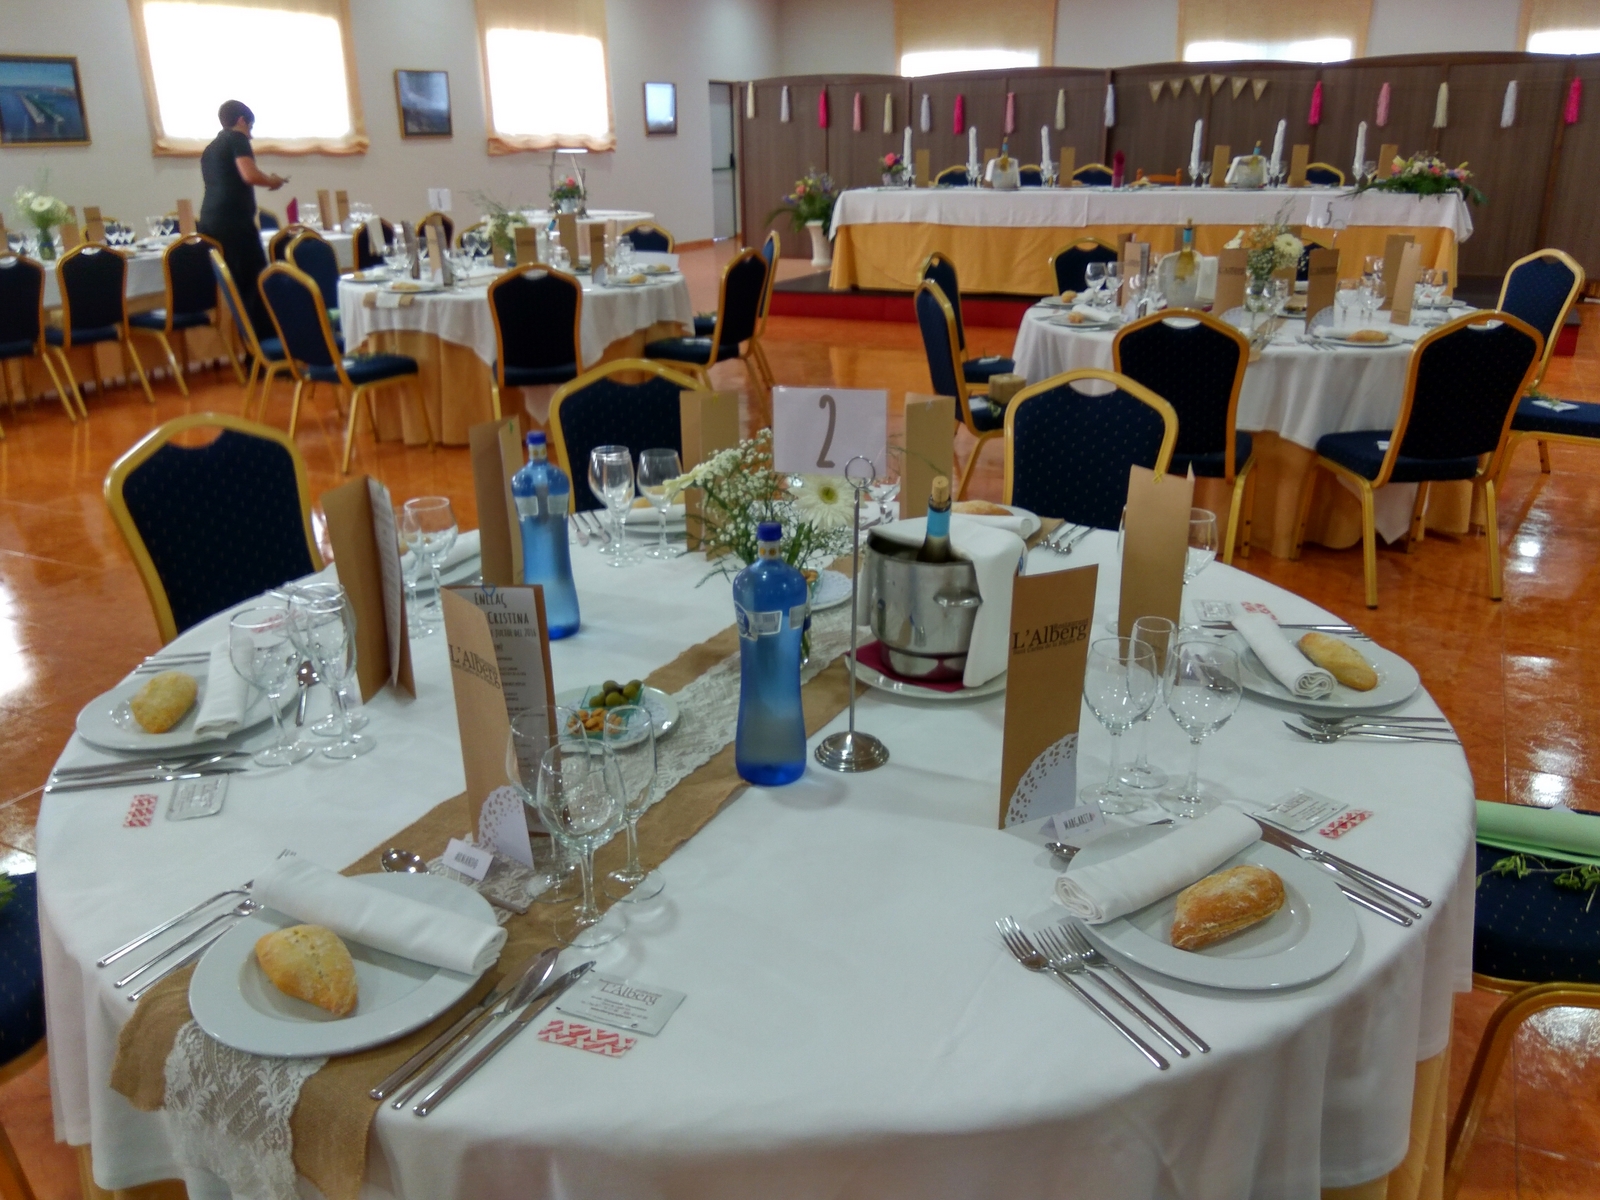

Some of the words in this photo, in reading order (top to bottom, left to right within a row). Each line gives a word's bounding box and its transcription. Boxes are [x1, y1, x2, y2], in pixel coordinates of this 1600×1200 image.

[1324, 201, 1333, 226] 5
[816, 394, 837, 468] 2
[487, 611, 530, 625] CRISTINA
[1012, 624, 1088, 650] L'Alberg
[448, 644, 501, 689] L'Alberg
[1063, 812, 1094, 831] MARGARITA
